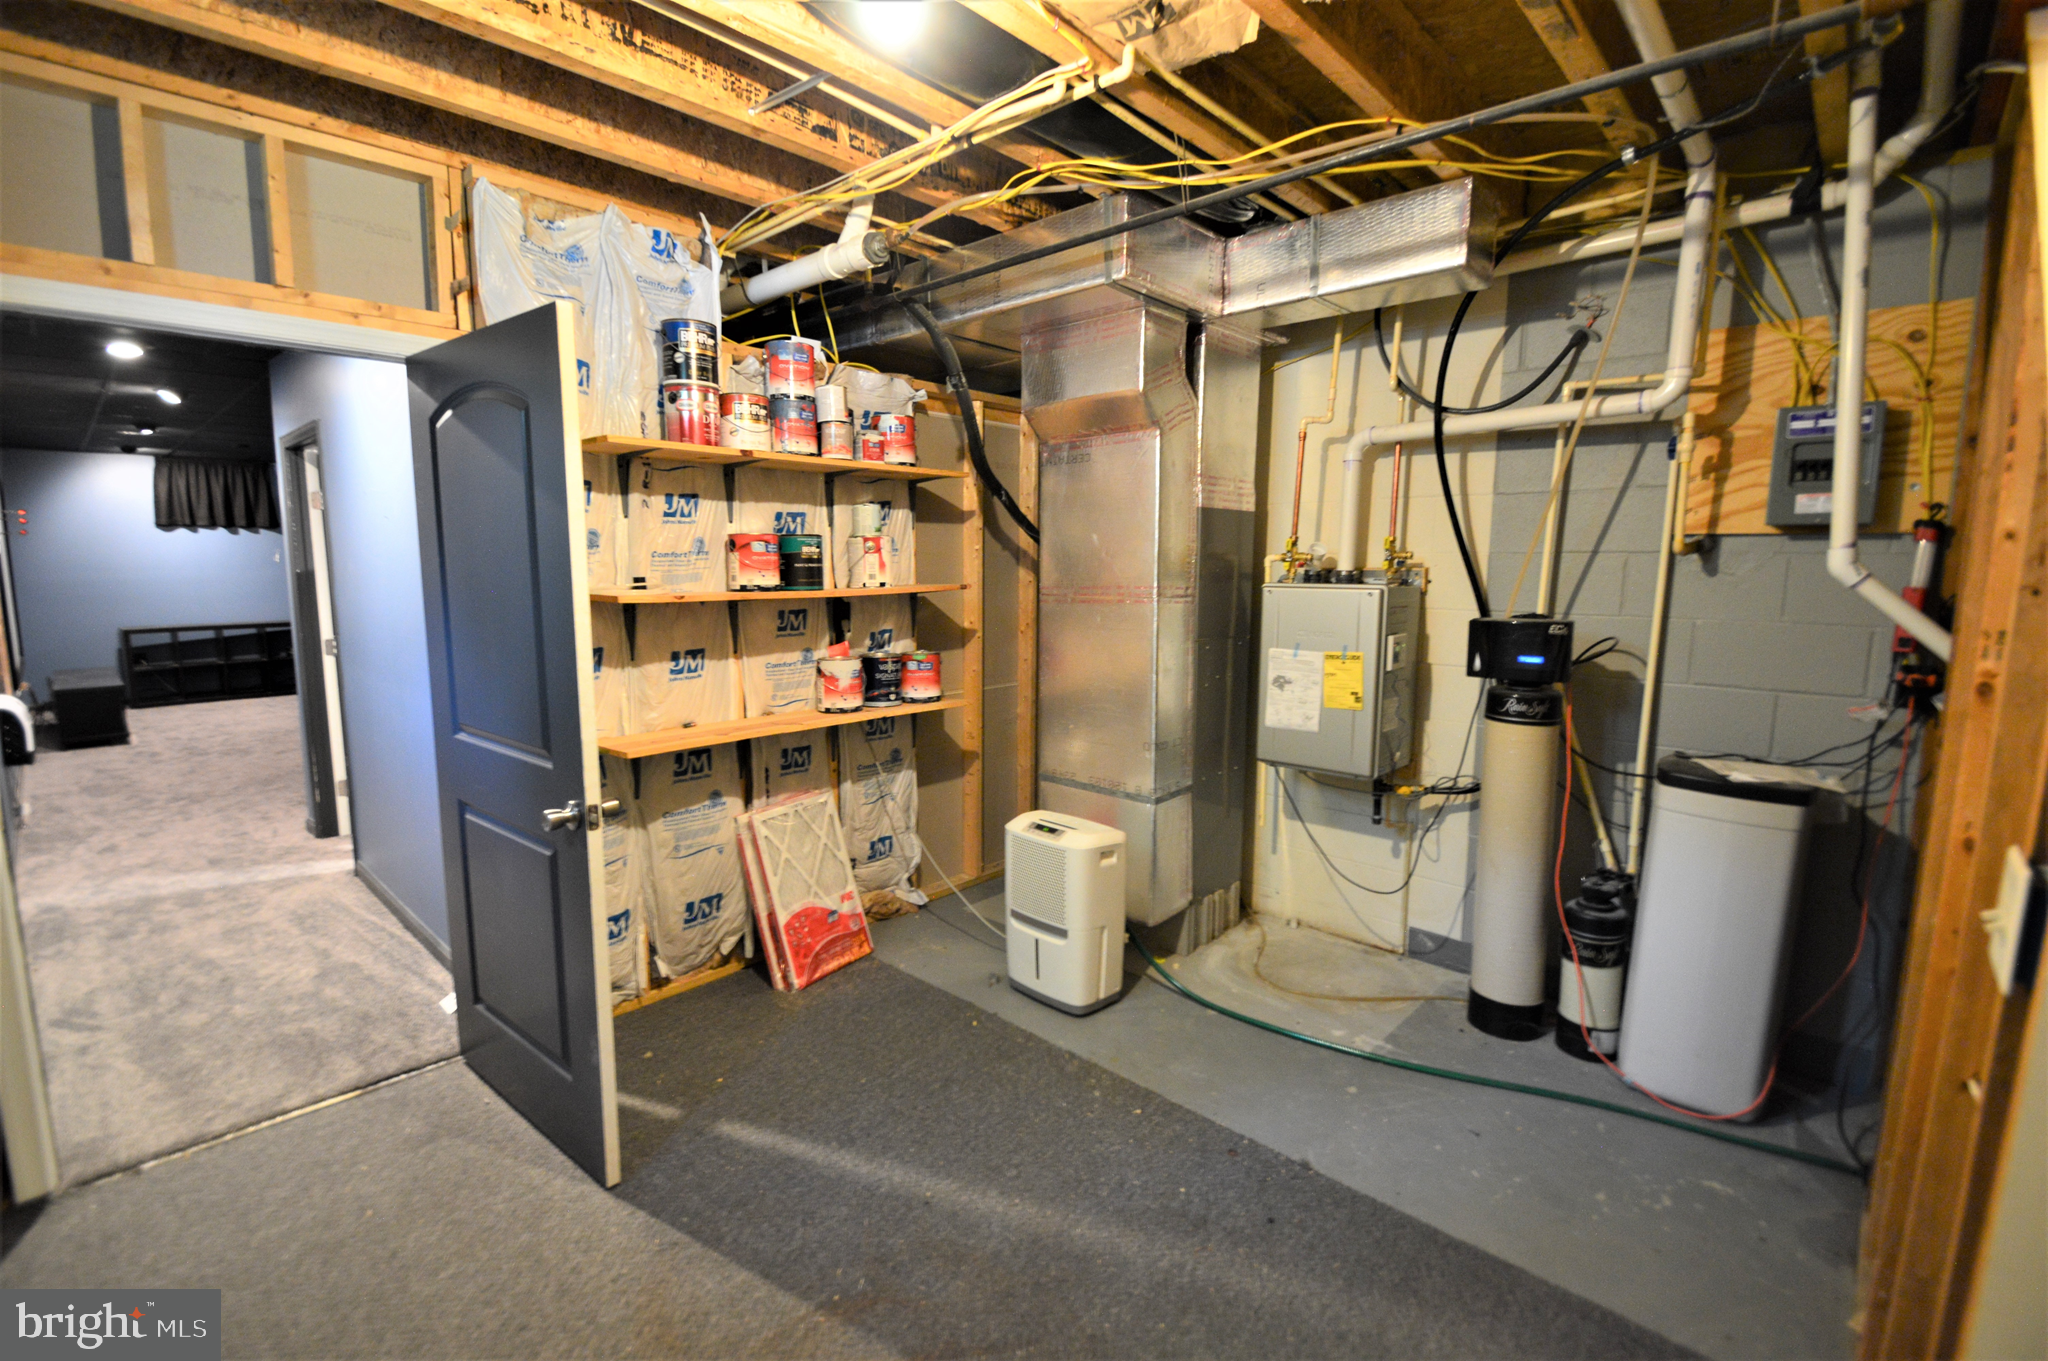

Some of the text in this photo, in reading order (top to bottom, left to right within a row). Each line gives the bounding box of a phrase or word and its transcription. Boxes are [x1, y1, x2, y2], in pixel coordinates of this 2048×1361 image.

[663, 493, 700, 518] JM
[773, 511, 806, 534] JM
[777, 609, 807, 632] JM
[669, 648, 706, 675] JM
[673, 748, 711, 778] JM
[780, 745, 811, 771] JM
[684, 892, 723, 924] JM
